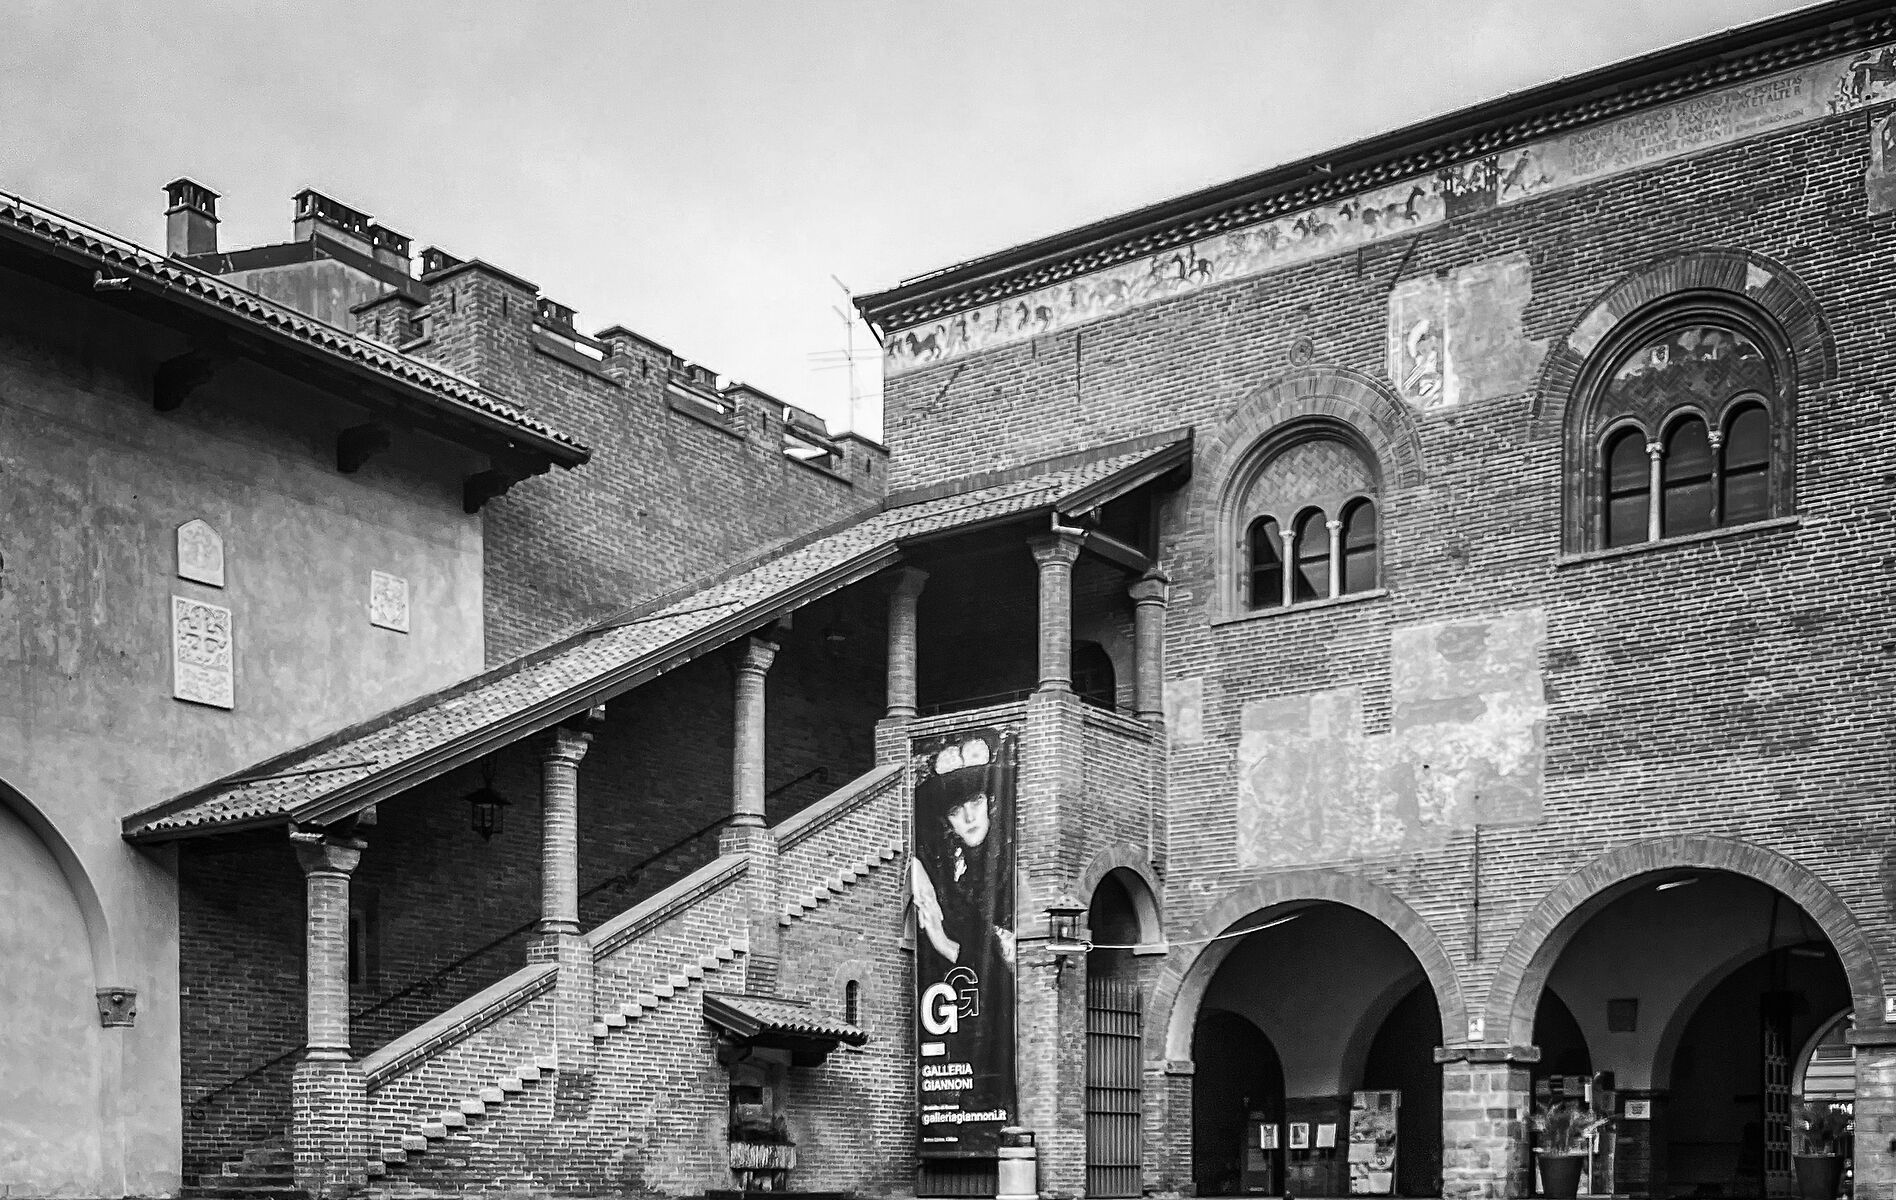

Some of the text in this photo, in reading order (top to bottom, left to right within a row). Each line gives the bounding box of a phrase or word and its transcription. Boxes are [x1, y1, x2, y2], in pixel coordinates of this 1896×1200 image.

[1754, 74, 1802, 95] POTESTAS
[921, 982, 958, 1036] G
[922, 1063, 973, 1077] GALLERIA
[922, 1078, 973, 1092] GIANNONI
[922, 1109, 1007, 1126] galleriagiannoni.it
